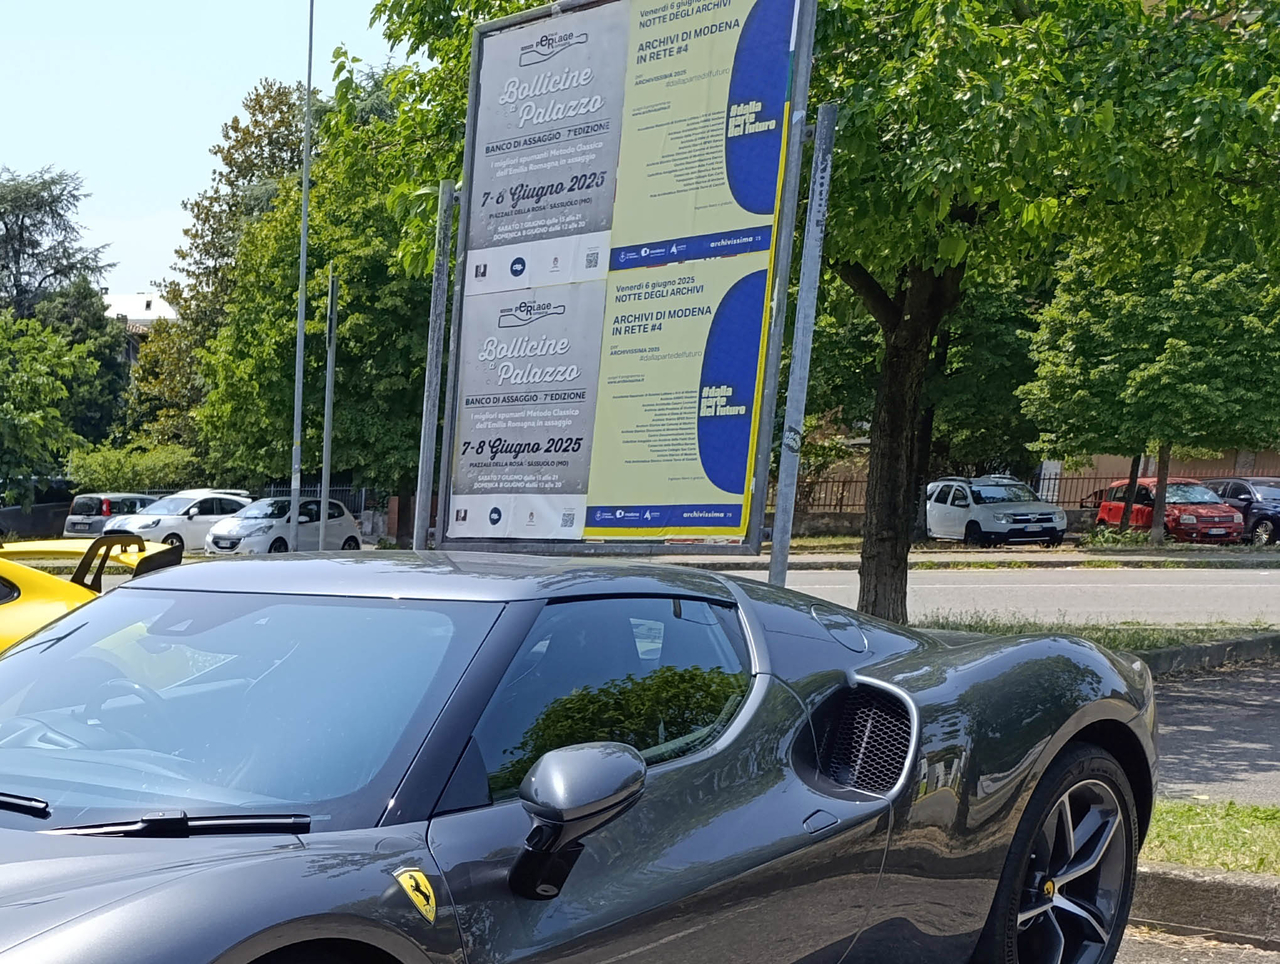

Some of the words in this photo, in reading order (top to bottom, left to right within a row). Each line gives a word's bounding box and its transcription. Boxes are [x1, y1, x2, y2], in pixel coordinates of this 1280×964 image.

[639, 14, 668, 29] NOTTE
[668, 8, 694, 21] DEGLI
[695, 0, 731, 15] ARCHIVI
[670, 2, 676, 10] 6
[637, 33, 679, 53] ARCHIVI
[681, 31, 692, 42] DI
[693, 18, 740, 39] MODENA
[636, 55, 647, 65] IN
[648, 47, 675, 62] RETE
[676, 43, 689, 55] #4
[499, 67, 595, 105] Bollicine
[519, 95, 605, 128] Palazzo
[745, 119, 776, 134] futuro
[485, 142, 512, 154] BANCO
[513, 140, 521, 149] DI
[522, 131, 561, 147] ASSAGGIO
[509, 183, 566, 209] Giugno
[567, 171, 607, 193] 2025
[710, 236, 753, 248] archivissima
[645, 282, 650, 290] 6
[651, 279, 677, 290] giugno
[677, 276, 696, 286] 2025
[615, 292, 643, 303] NOTTE
[643, 289, 669, 301] DEGLI
[669, 285, 705, 297] ARCHIVI
[613, 312, 654, 325] ARCHIVI
[655, 311, 666, 321] DI
[667, 305, 712, 319] MODENA
[612, 327, 622, 336] IN
[623, 324, 649, 336] RETE
[650, 322, 663, 332] #4
[478, 334, 571, 361] Bollicine
[610, 347, 647, 356] ARCHIVISSIMA
[498, 361, 582, 386] Palazzo
[465, 396, 491, 406] BANCO
[492, 396, 500, 404] DI
[501, 394, 538, 403] ASSAGGIO
[716, 405, 746, 416] futuro
[461, 440, 486, 456] 7-8
[488, 437, 543, 461] Giugno
[543, 437, 583, 453] 2025
[555, 460, 569, 468] (MO)
